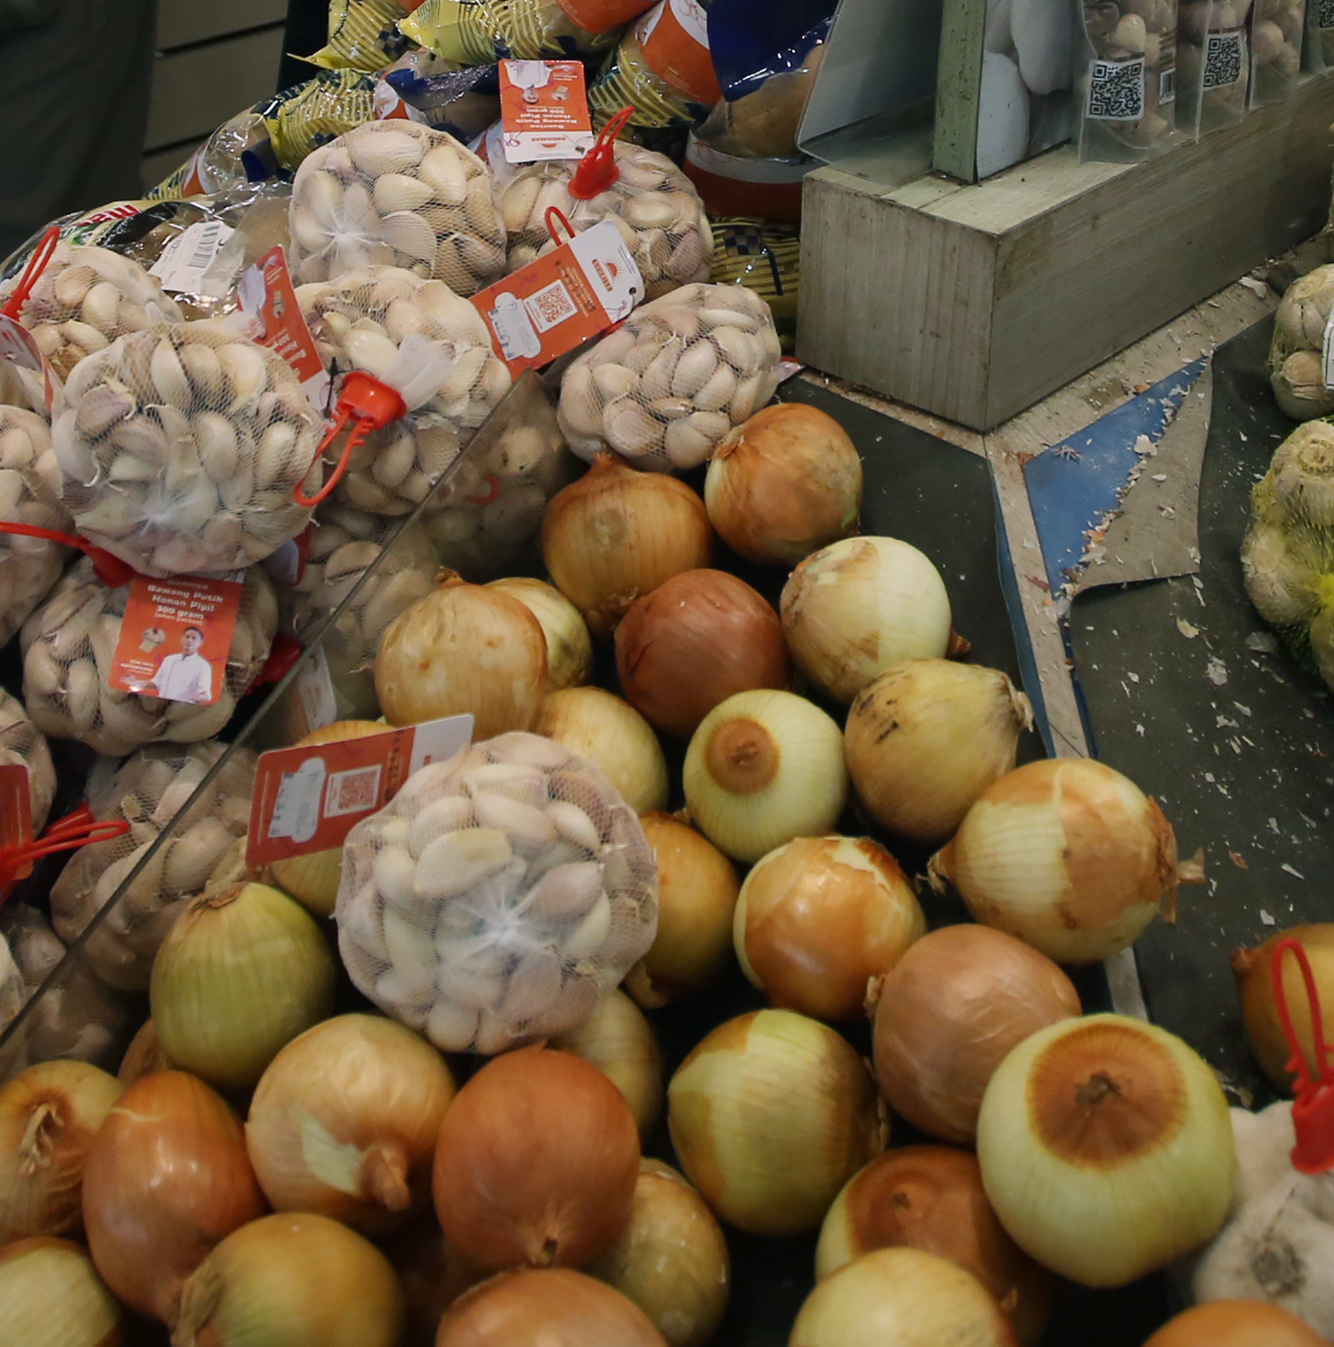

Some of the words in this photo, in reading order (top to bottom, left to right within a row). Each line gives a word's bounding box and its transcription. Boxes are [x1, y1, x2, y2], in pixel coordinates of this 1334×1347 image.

[148, 584, 190, 598] Bawang
[193, 591, 223, 603] Putih
[152, 595, 186, 607] Honan
[190, 601, 214, 612] Pipil
[156, 605, 175, 614] 300
[177, 610, 204, 620] gram
